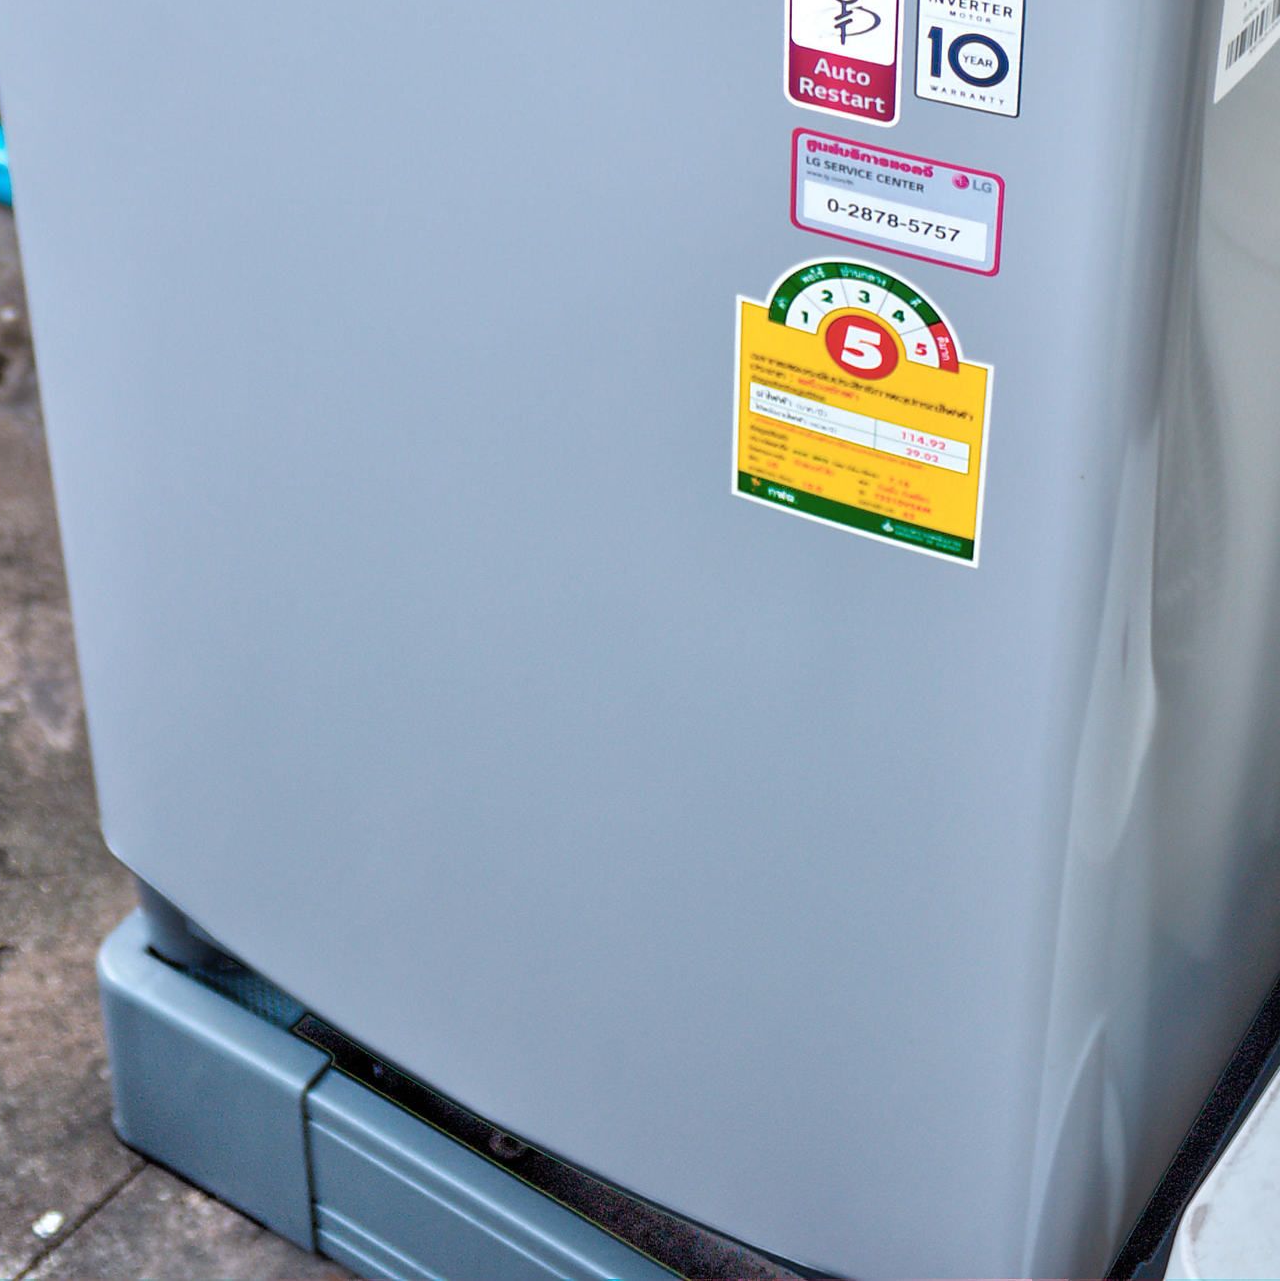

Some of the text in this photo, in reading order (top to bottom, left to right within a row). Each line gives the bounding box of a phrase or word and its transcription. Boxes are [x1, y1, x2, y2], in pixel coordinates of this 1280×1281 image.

[949, 11, 992, 23] MOTOR
[927, 26, 1009, 87] 10
[962, 54, 993, 69] YEAR
[814, 58, 871, 86] Auto
[799, 77, 885, 114] Restart
[930, 85, 1005, 106] WARRANTY
[806, 156, 925, 193] LG SERVICE CENTER
[972, 180, 992, 194] LG
[827, 199, 960, 242] 0-2878-5757
[821, 289, 833, 304] 2
[858, 290, 870, 303] 3
[801, 310, 808, 323] 1
[892, 310, 904, 323] 4
[840, 325, 884, 370] 5
[915, 343, 927, 356] 5
